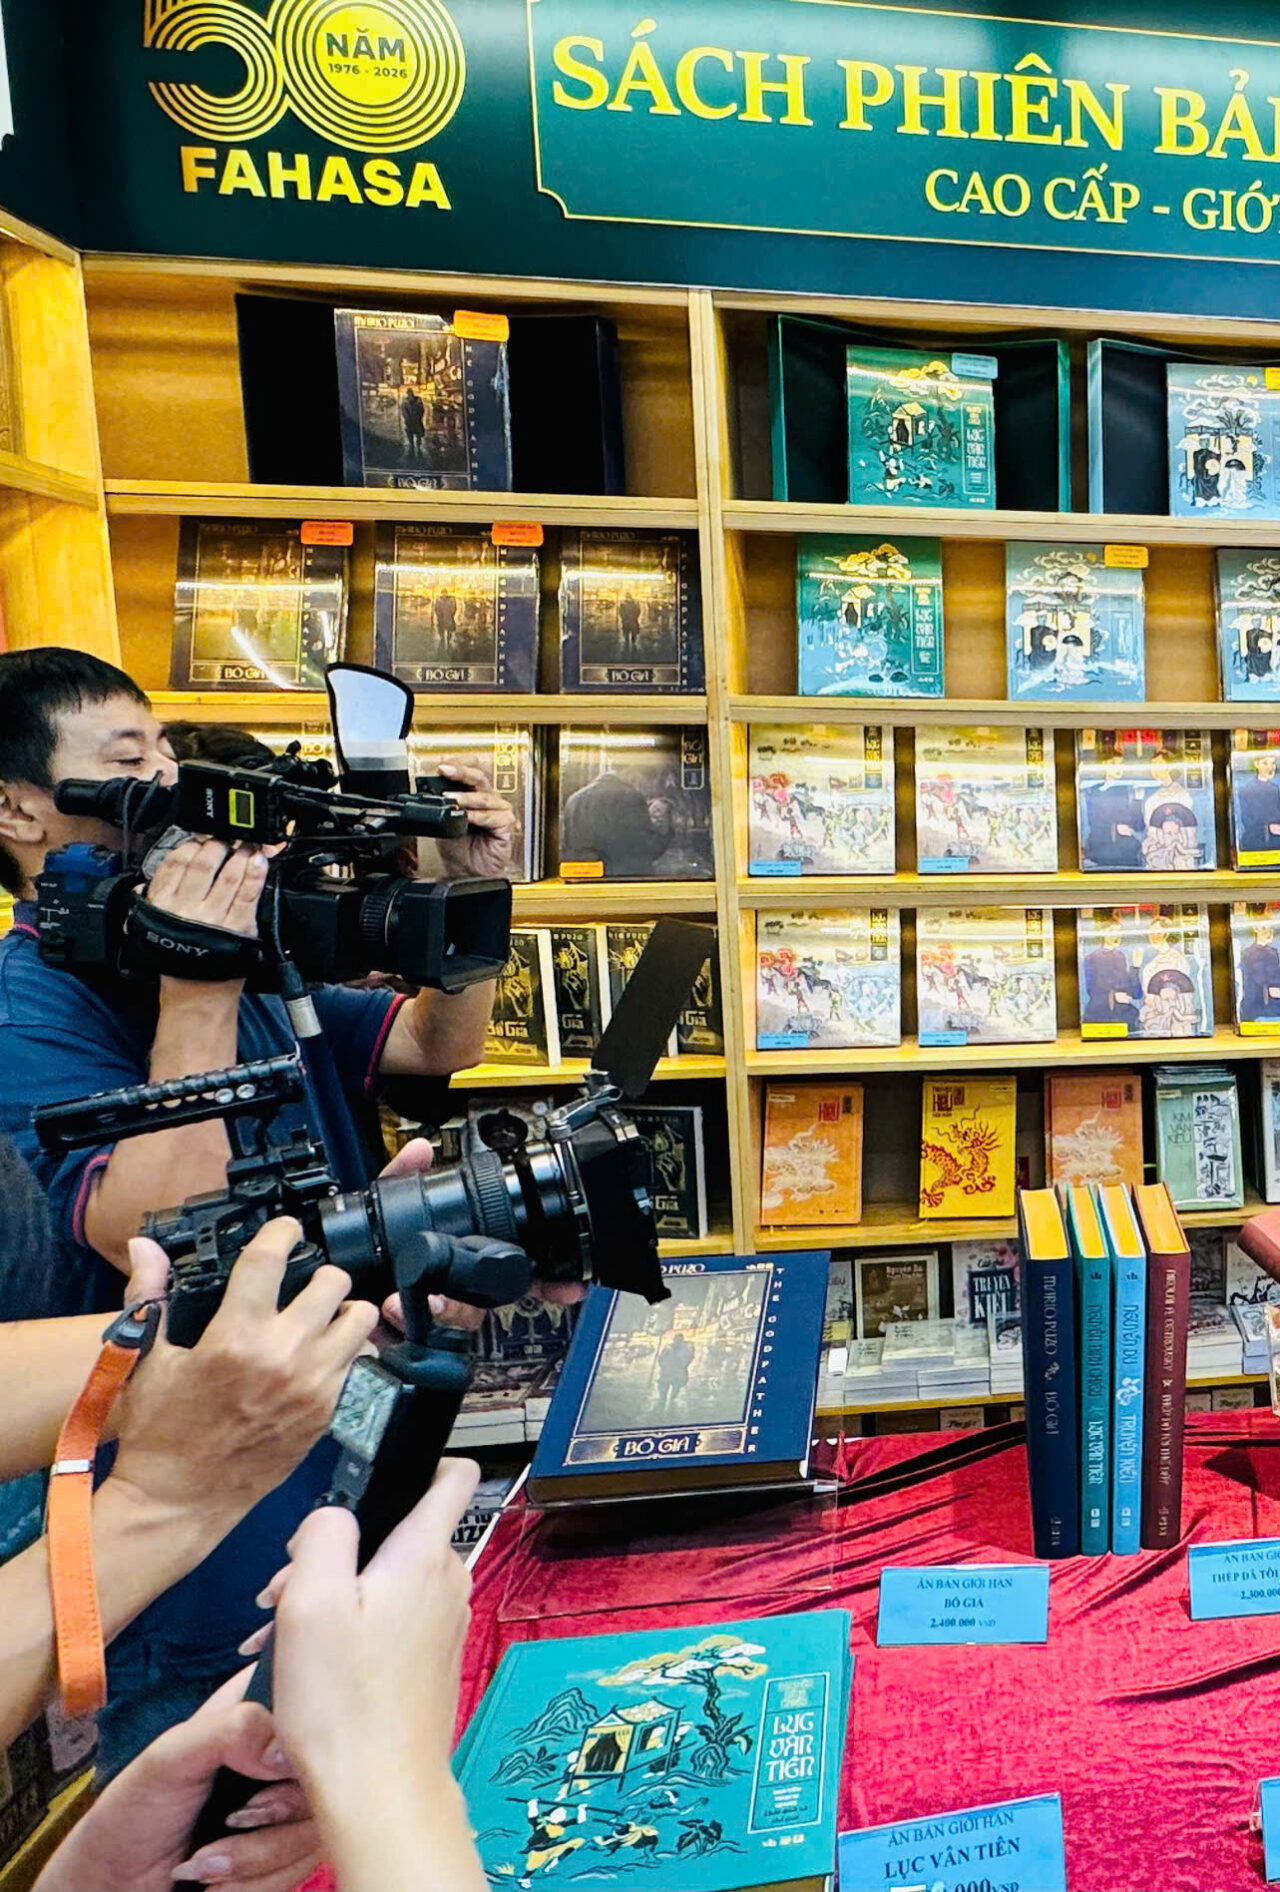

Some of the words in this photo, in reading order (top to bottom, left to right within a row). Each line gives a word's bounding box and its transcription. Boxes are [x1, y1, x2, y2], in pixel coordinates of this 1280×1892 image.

[326, 27, 407, 63] NĂM
[328, 63, 361, 75] 1976
[374, 66, 408, 80] 2026
[552, 18, 813, 127] SÁCH
[837, 52, 1131, 151] PHIÊN
[181, 145, 452, 211] FAHASA
[925, 168, 1031, 219] CAO
[1044, 163, 1141, 224] CẤP
[145, 931, 210, 959] SONY
[773, 1711, 816, 1735] LỤC
[884, 1855, 926, 1880] LỤC
[929, 1845, 971, 1868] VÂN
[972, 1836, 1022, 1861] TIÊN
